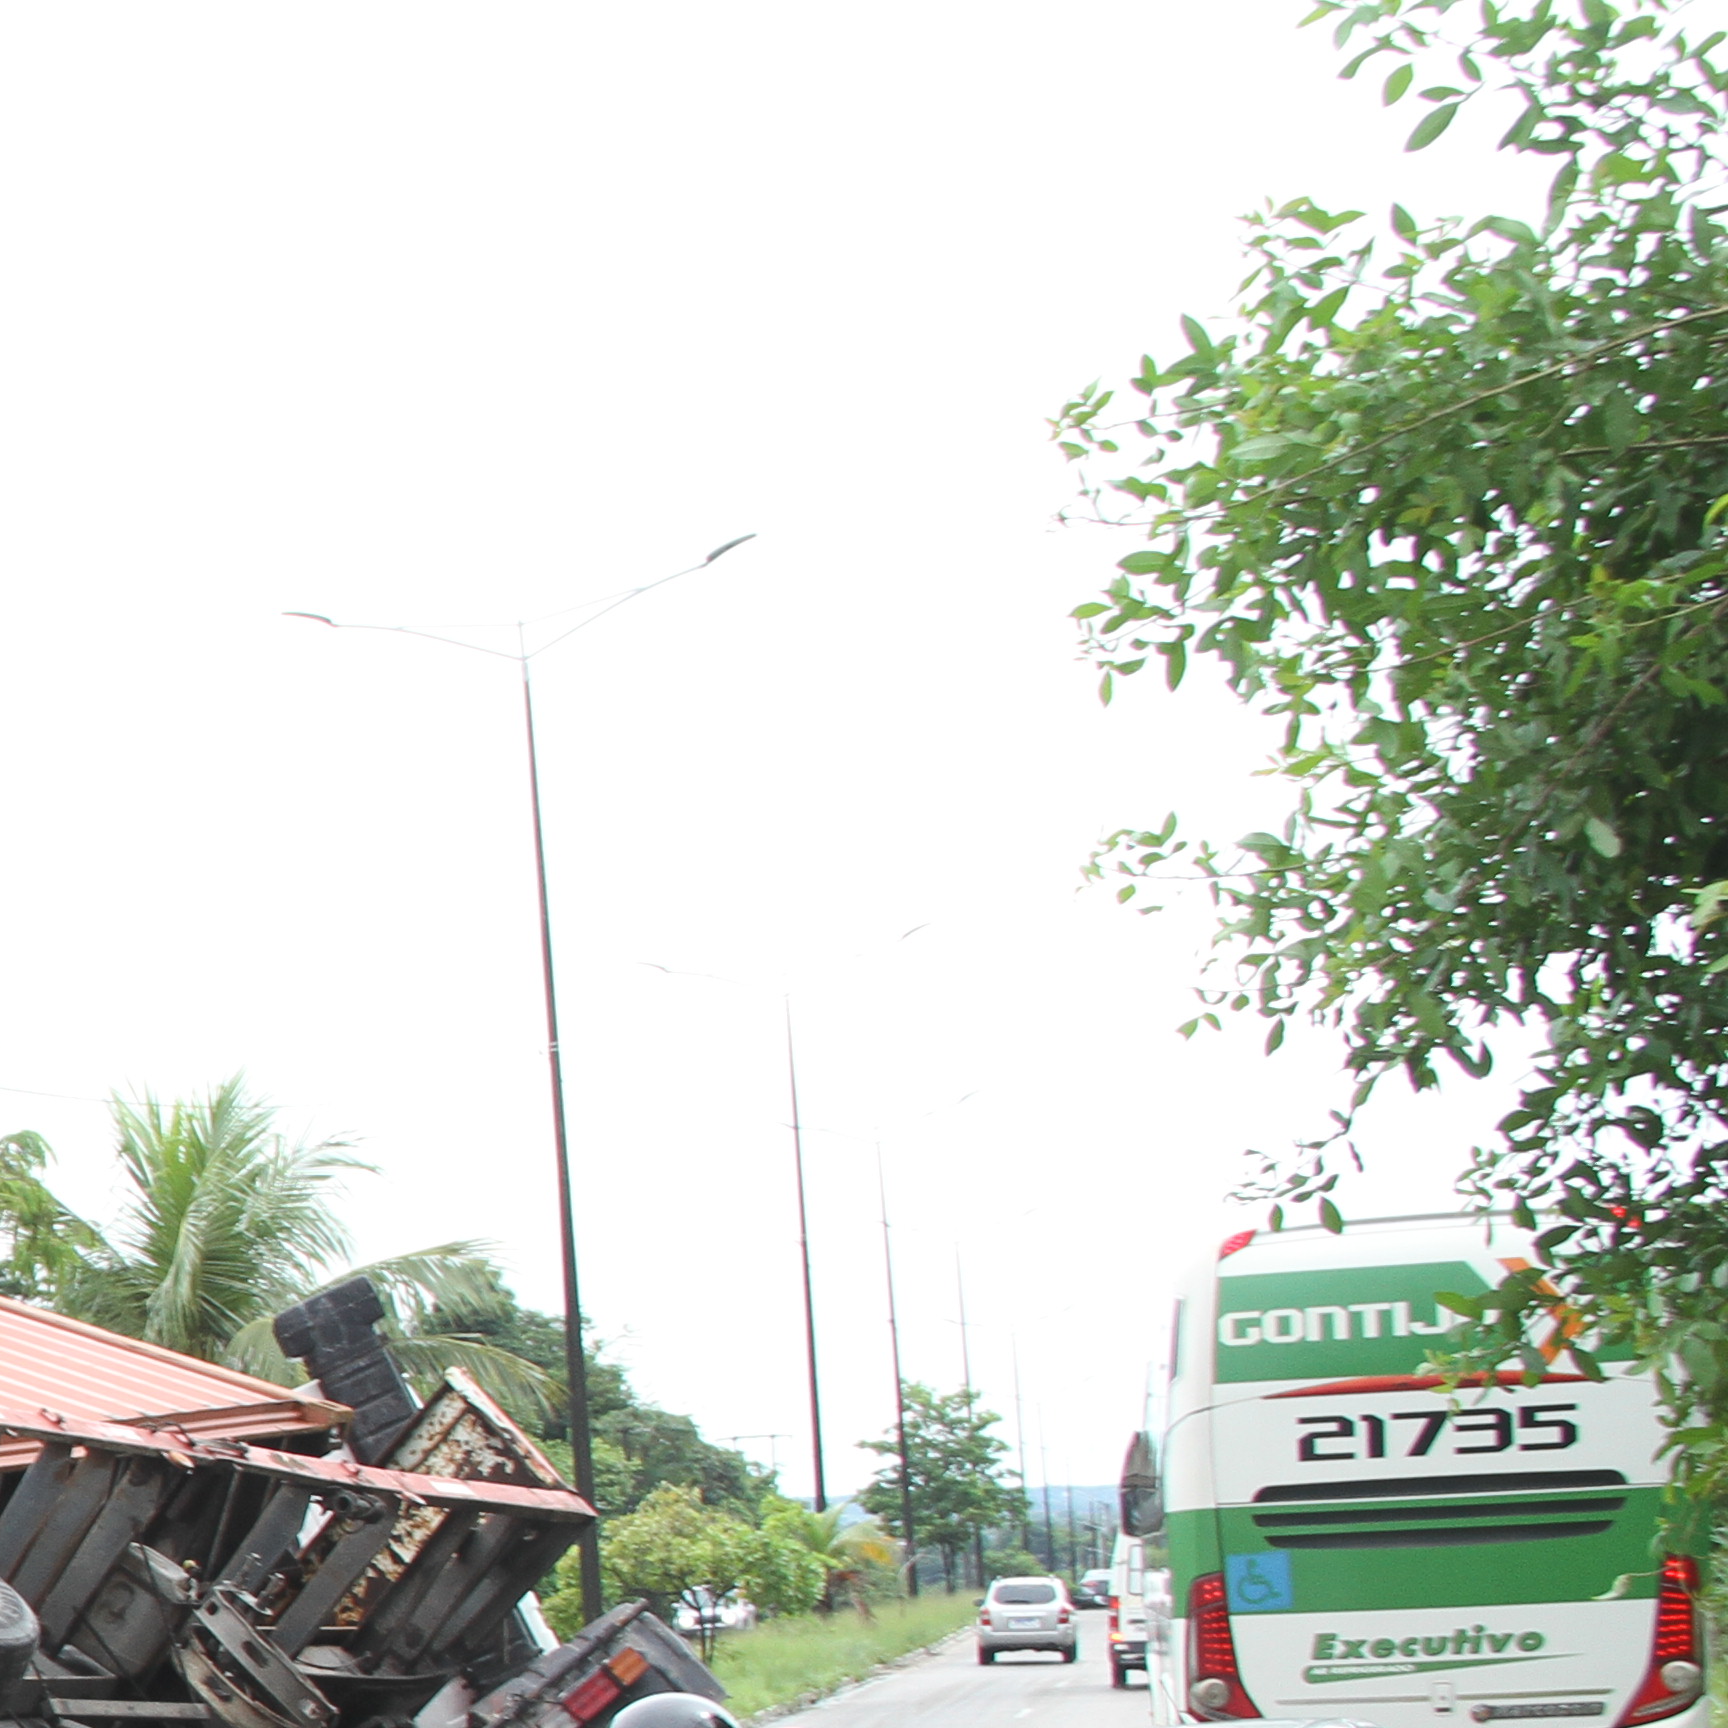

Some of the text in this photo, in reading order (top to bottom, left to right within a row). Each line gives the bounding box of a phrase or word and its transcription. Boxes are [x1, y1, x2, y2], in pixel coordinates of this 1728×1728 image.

[1217, 1300, 1501, 1346] GONTIJ
[1296, 1403, 1578, 1462] 21735
[1311, 1624, 1546, 1660] Executivo
